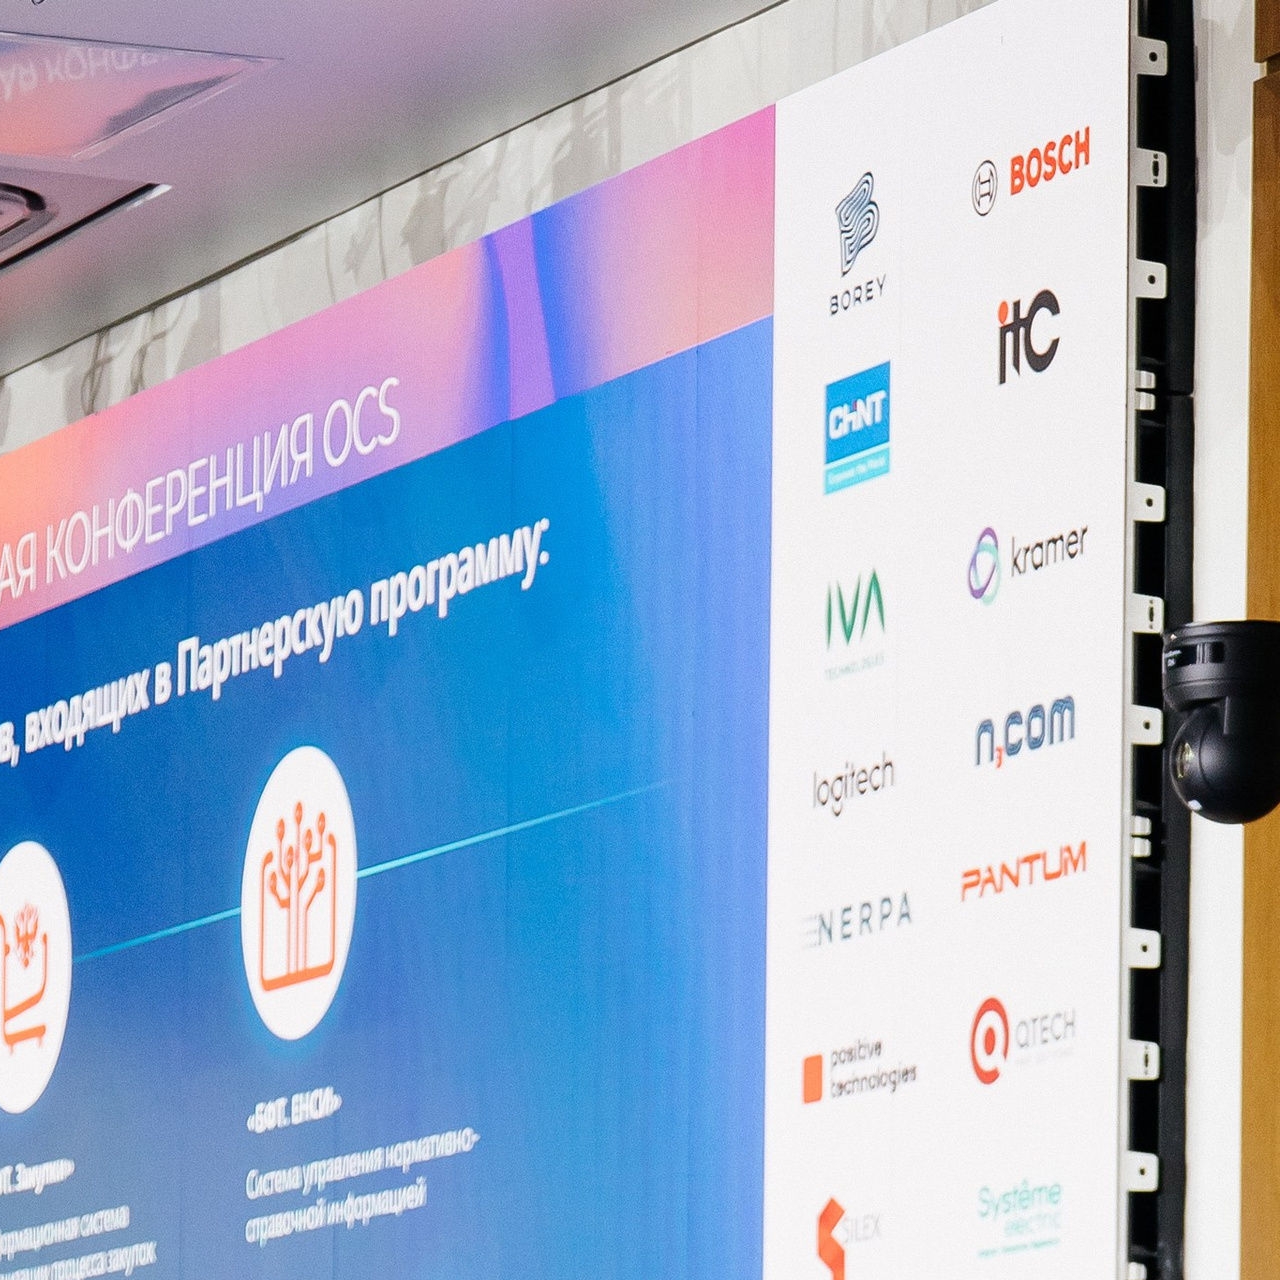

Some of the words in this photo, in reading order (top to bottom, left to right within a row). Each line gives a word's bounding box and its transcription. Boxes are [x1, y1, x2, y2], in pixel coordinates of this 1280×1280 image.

[1010, 126, 1090, 196] BOSCH
[829, 274, 887, 316] BOREY
[46, 412, 314, 585] КОНФЕРЕНЦИЯ
[323, 377, 400, 467] OCS
[1011, 525, 1089, 577] kramer
[25, 669, 150, 752] входящих
[154, 662, 172, 705] в
[177, 588, 364, 701] Партнерскую
[370, 517, 550, 636] программу:
[813, 751, 896, 818] logitech
[960, 841, 1087, 902] PANTUM
[818, 892, 912, 945] NERPA
[830, 1039, 883, 1068] positive
[1015, 1008, 1076, 1049] QTECH
[830, 1063, 917, 1098] technologies
[246, 1165, 302, 1199] Система
[302, 1147, 385, 1195] управления
[386, 1127, 481, 1173] нормативно-
[81, 1205, 130, 1237] система
[246, 1198, 326, 1248] справочной
[327, 1176, 428, 1229] информацией
